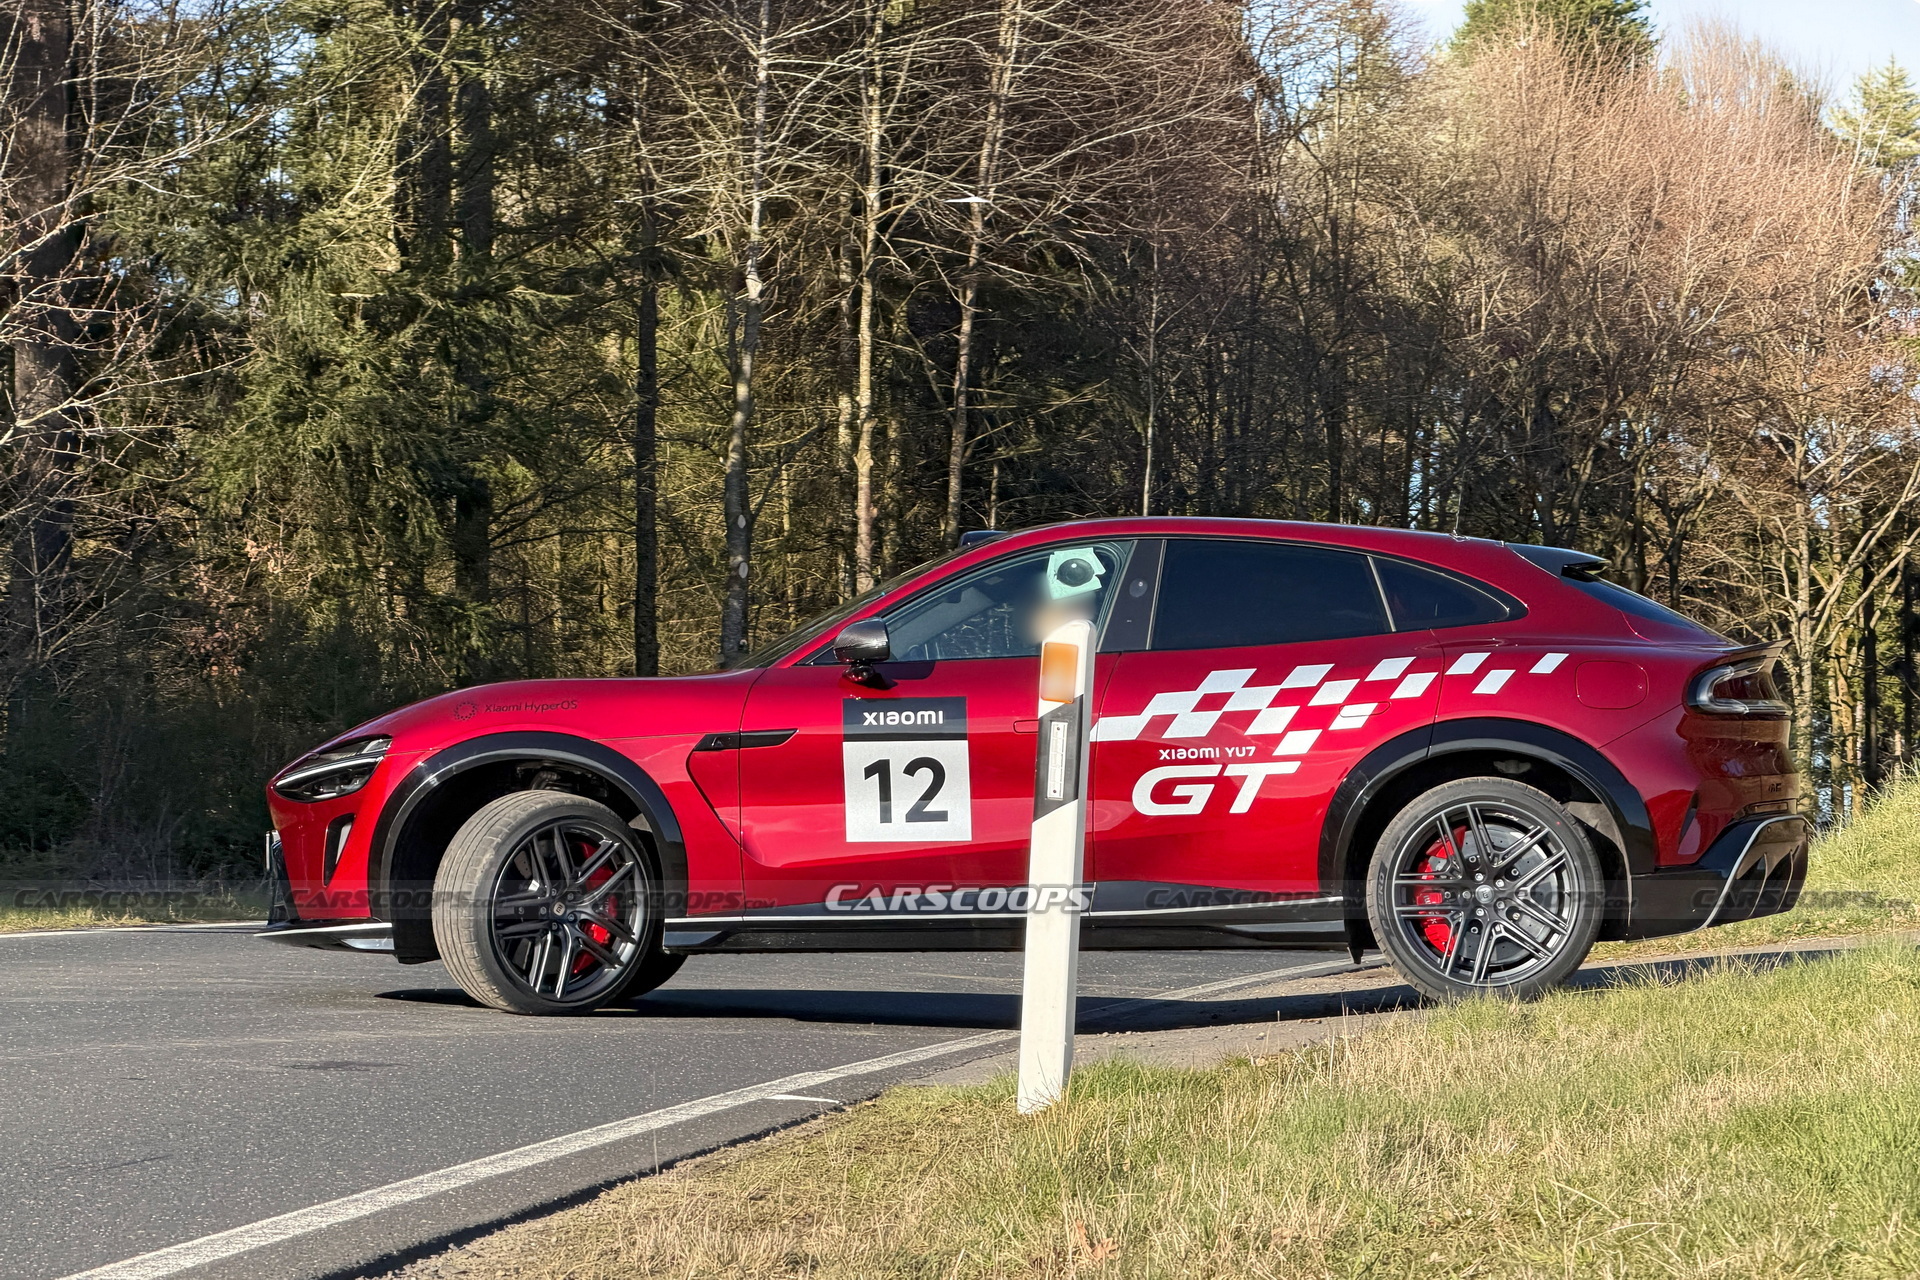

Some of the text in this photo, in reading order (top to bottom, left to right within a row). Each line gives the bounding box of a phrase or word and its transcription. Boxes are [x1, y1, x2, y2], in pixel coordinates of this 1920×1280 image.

[484, 700, 578, 713] Xiaomi HyperOS
[1225, 746, 1256, 758] YU7
[864, 756, 949, 824] 12
[1132, 761, 1302, 816] GT
